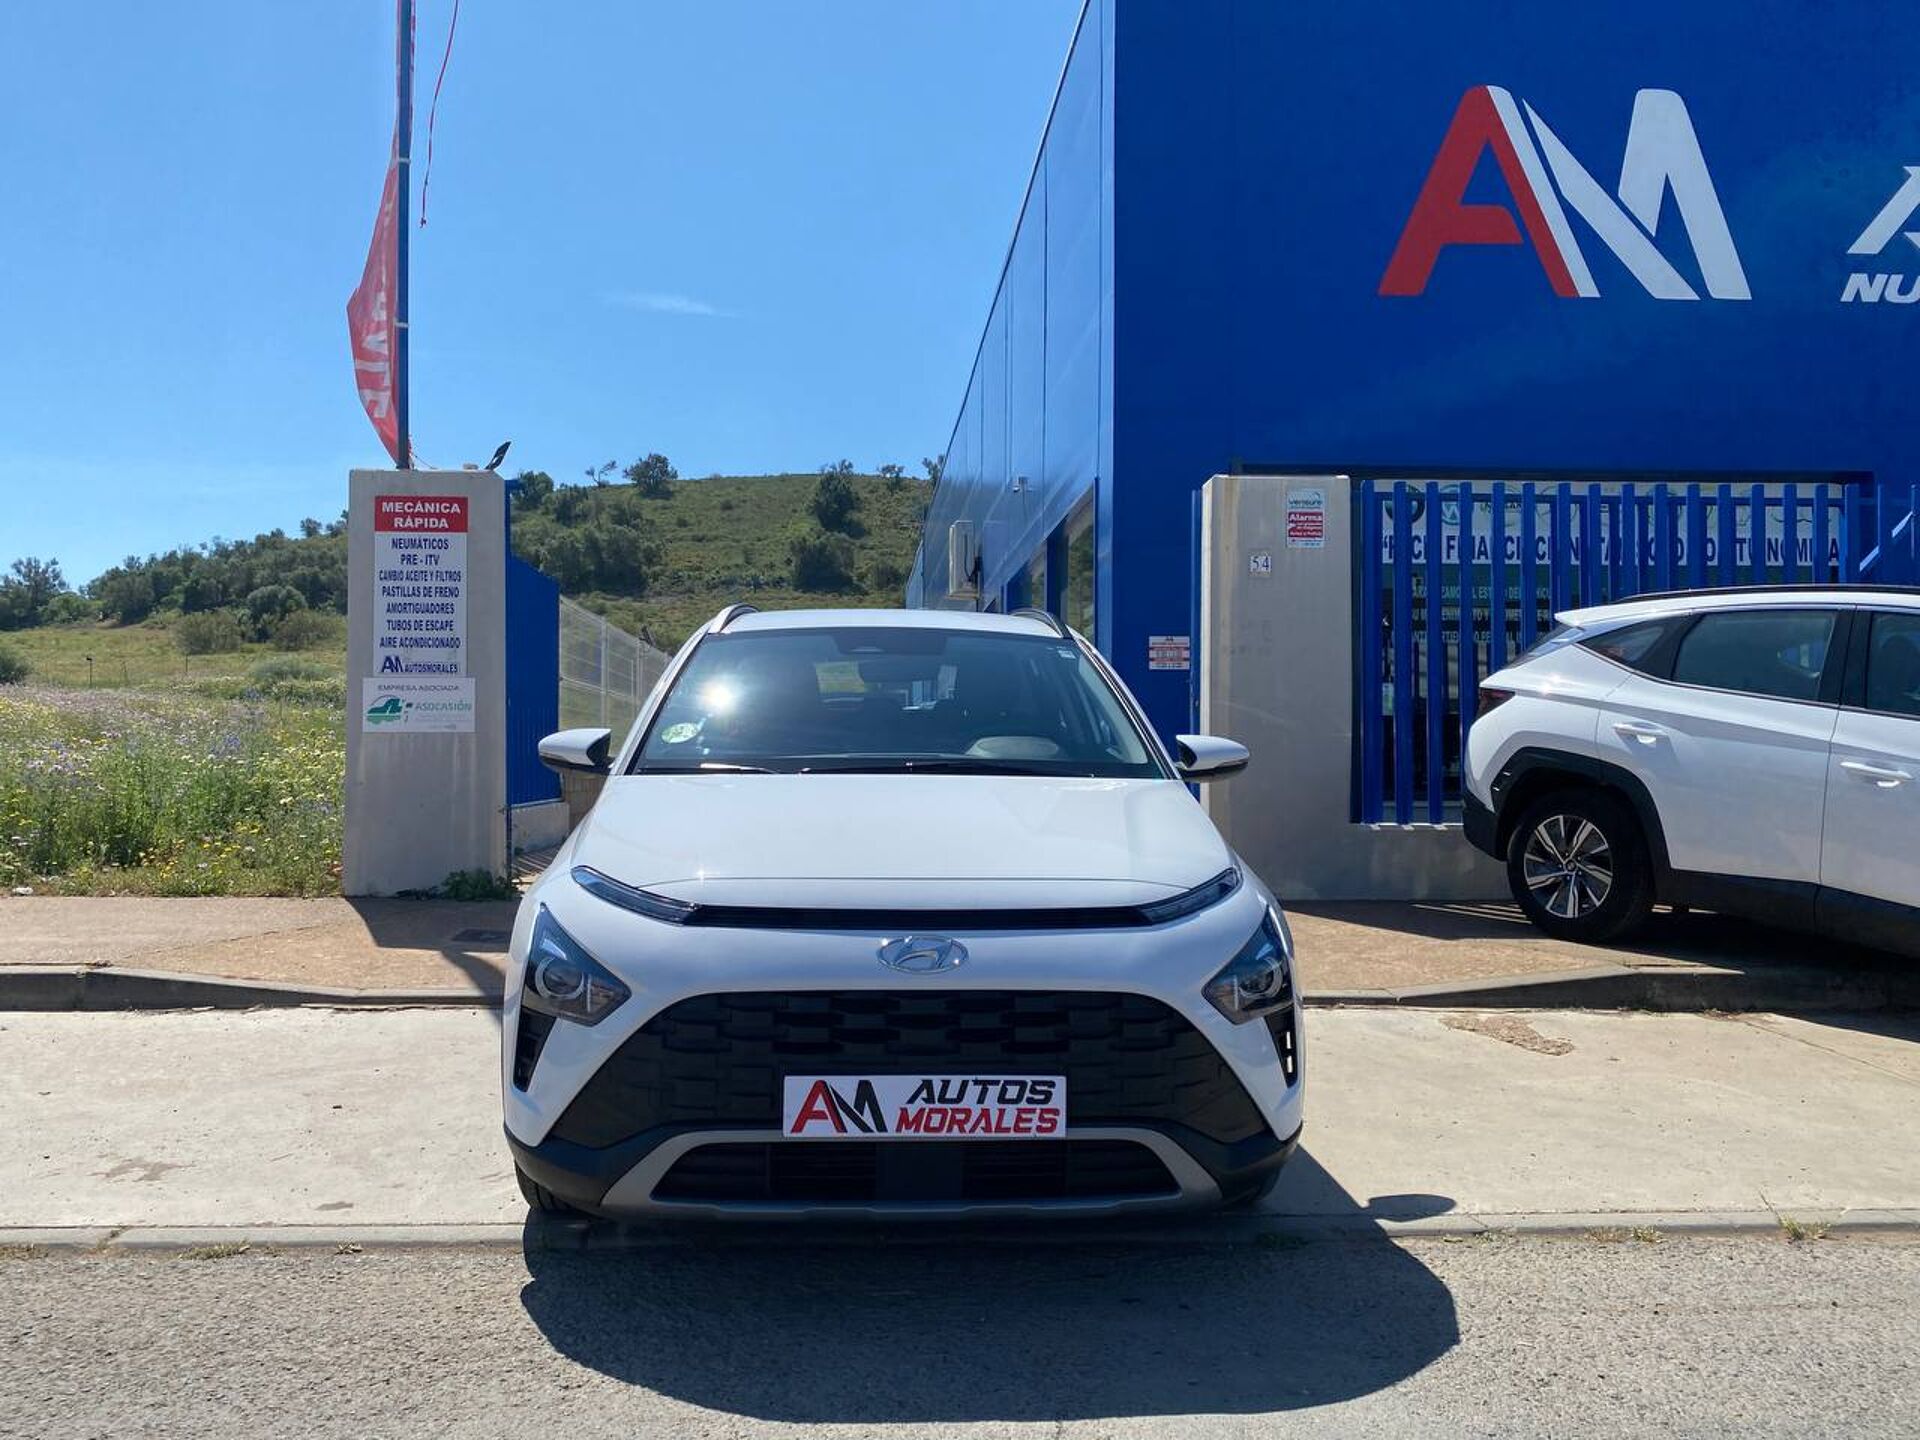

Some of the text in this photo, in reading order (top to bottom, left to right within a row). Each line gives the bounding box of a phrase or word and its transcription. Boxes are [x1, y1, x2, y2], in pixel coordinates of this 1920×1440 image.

[1378, 85, 1752, 300] AM
[382, 500, 461, 514] MECÁNICA
[394, 514, 449, 529] RÁPIDA
[391, 537, 449, 550] NEUMÁTICOS
[400, 554, 418, 565] PRE
[425, 554, 440, 565] ITV
[1252, 555, 1270, 571] 54
[379, 570, 461, 582] CAMBIO ACEITE Y FILTROS
[382, 586, 460, 598] PASTILLAS DE FRENO
[386, 602, 455, 615] AMORTIGUADORES
[387, 619, 454, 631] TUBOS DE ESCAPE
[379, 636, 461, 649] AIRE ACONDICIONADO
[378, 684, 417, 692] EMPRESA
[790, 1079, 1056, 1134] AM AUTOS
[896, 1107, 1061, 1134] MORALES
